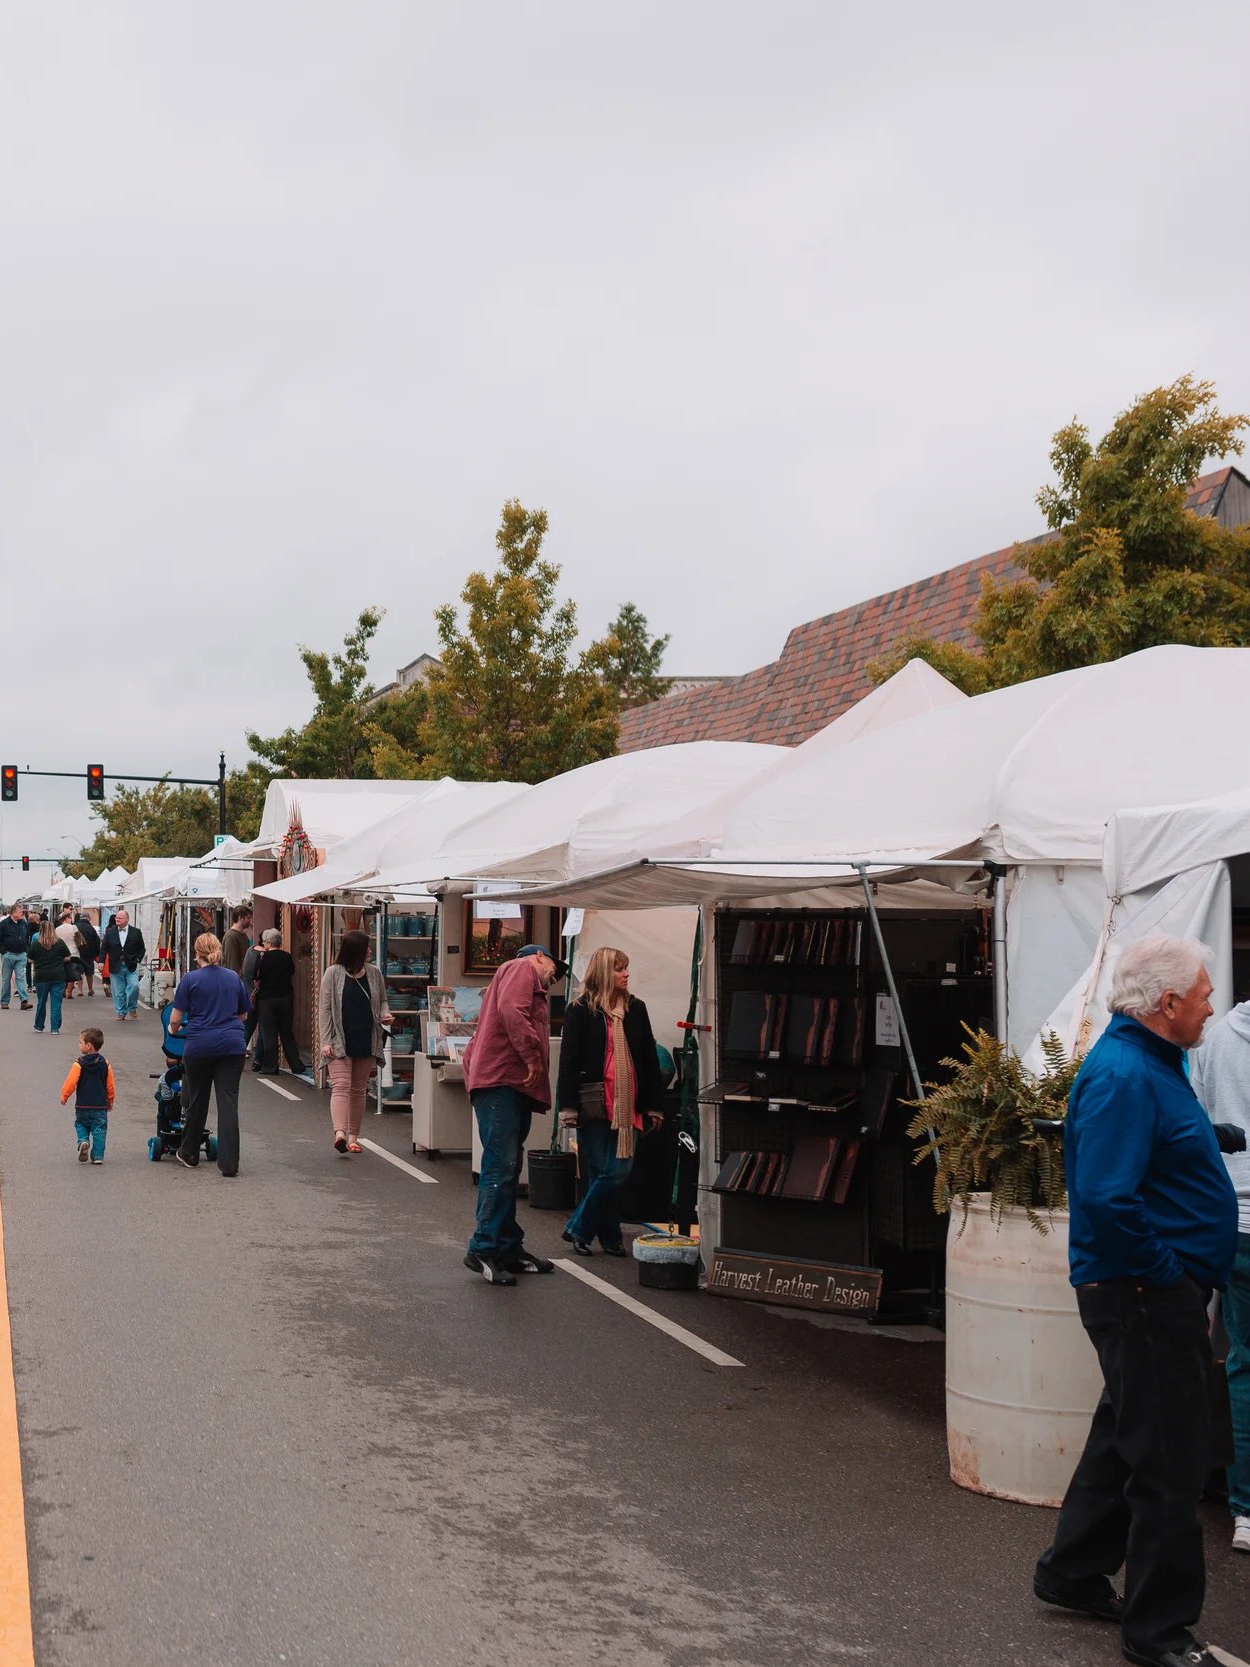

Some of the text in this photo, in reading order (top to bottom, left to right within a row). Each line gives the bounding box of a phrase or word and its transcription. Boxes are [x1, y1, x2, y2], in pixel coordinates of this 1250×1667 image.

[710, 1261, 870, 1310] Harvest Leather Design
